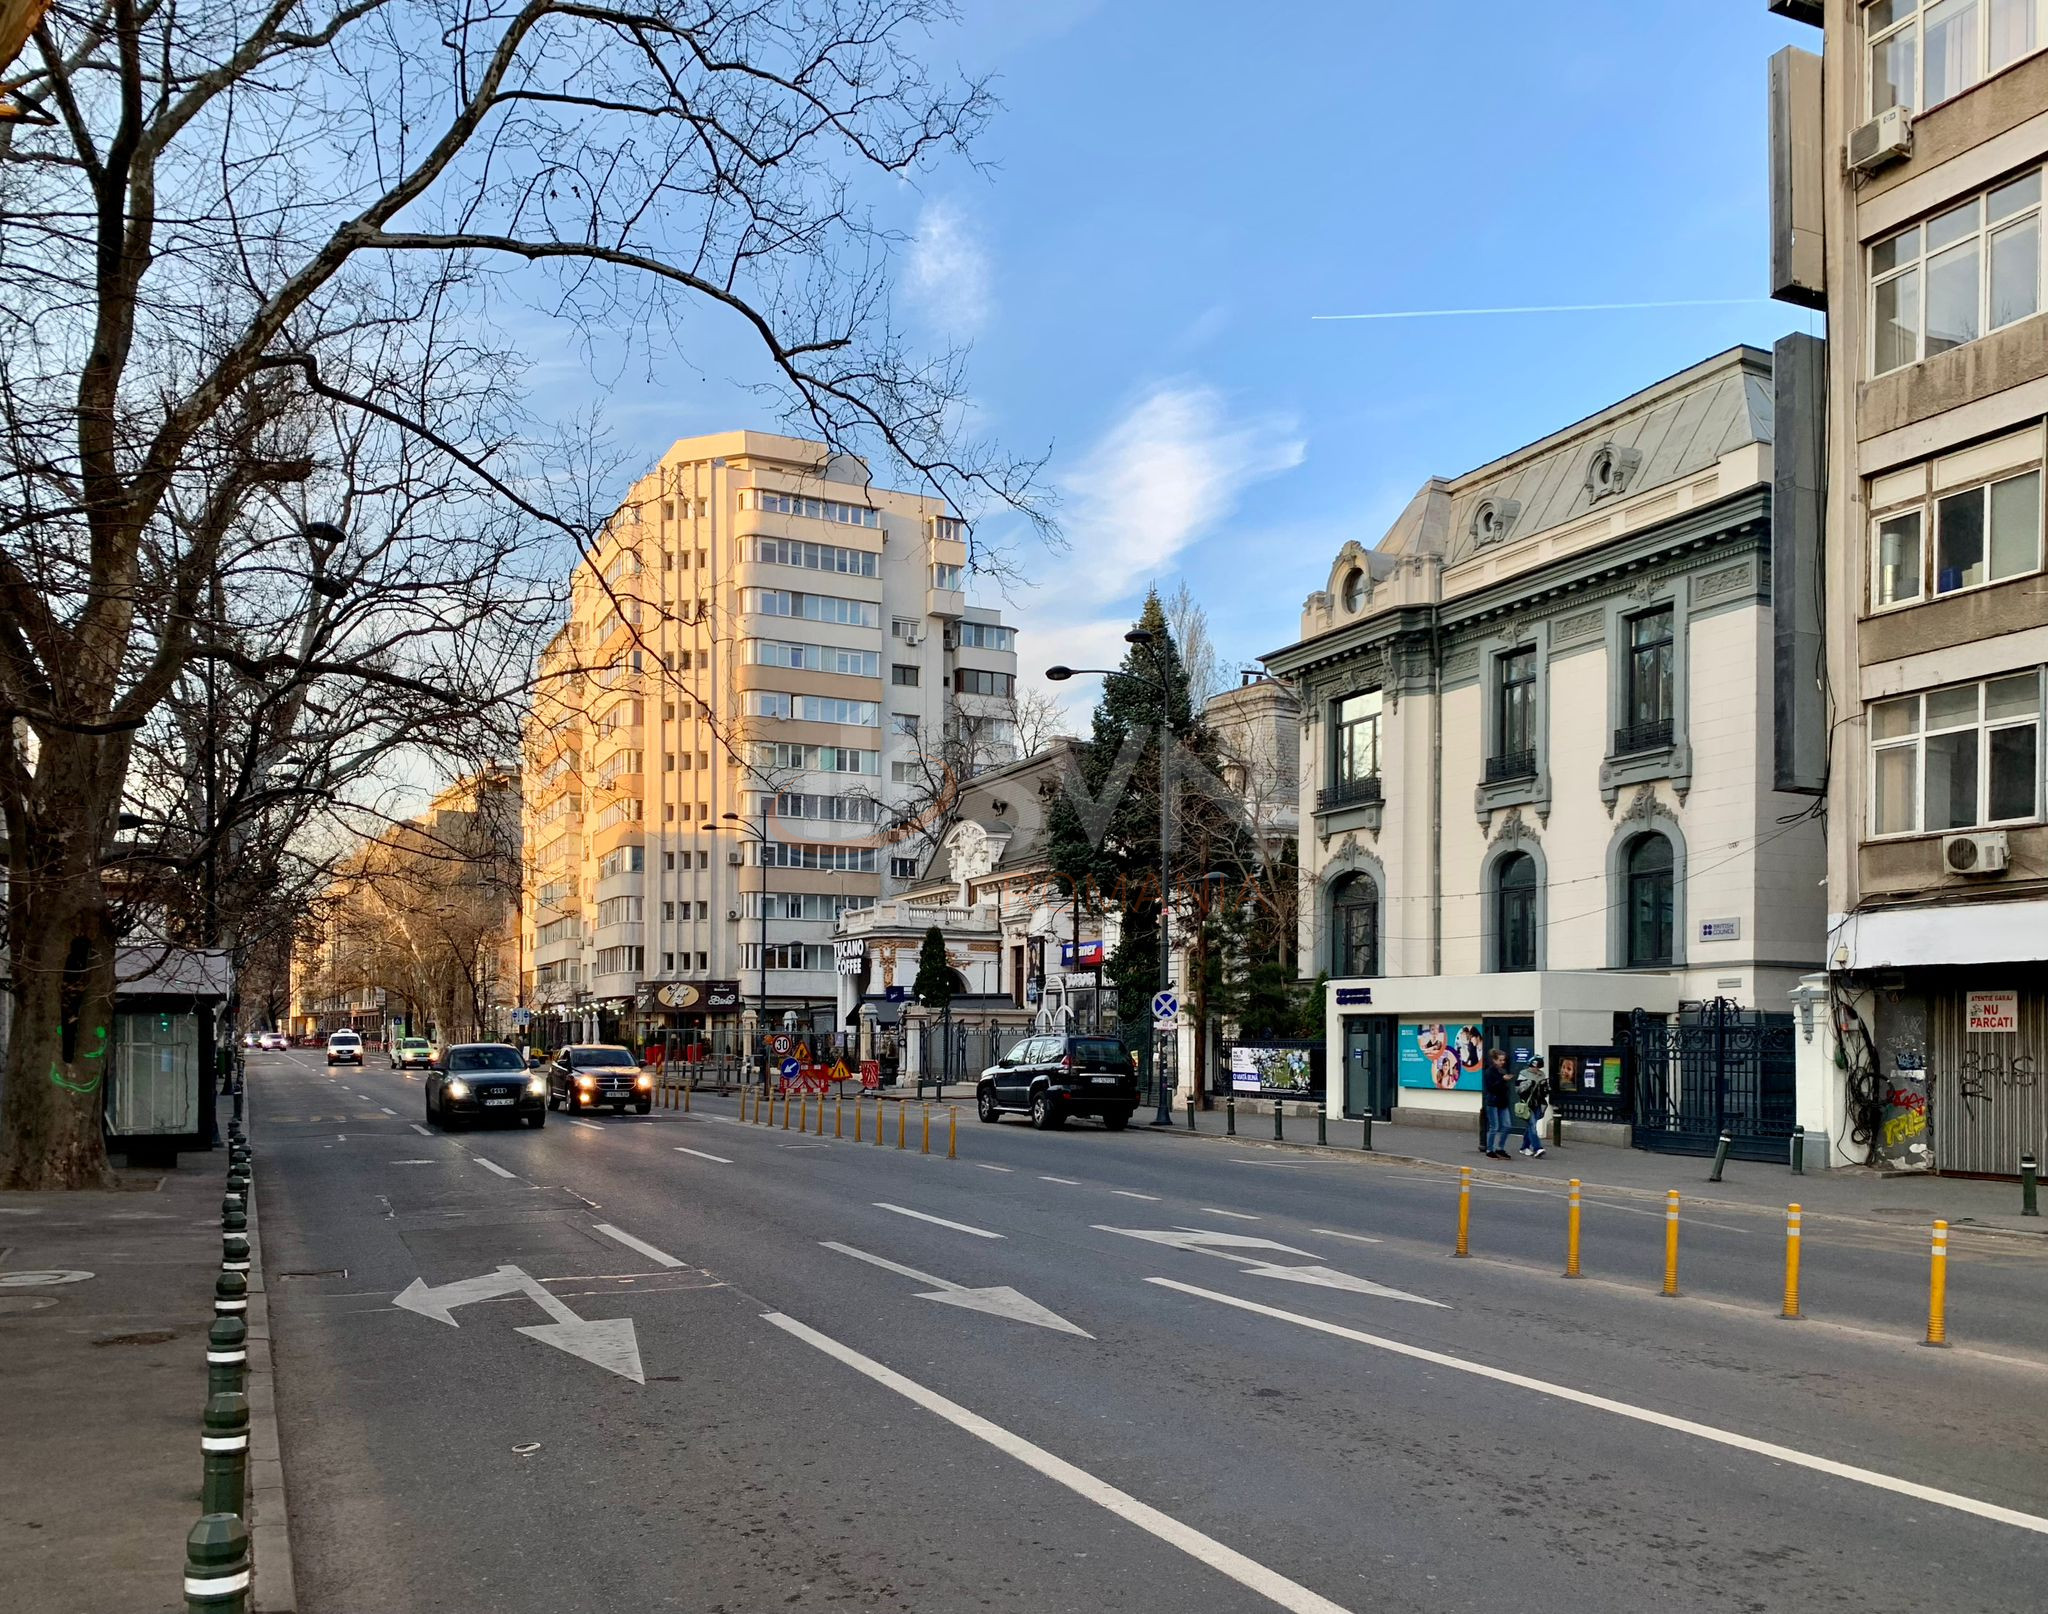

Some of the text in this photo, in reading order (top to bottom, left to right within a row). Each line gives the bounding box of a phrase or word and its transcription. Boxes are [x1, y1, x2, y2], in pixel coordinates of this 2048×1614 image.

[834, 939, 863, 958] TUCANO
[837, 958, 862, 975] COFFEE
[1983, 1004, 1999, 1015] NU
[1970, 1016, 2013, 1028] PARCATI
[776, 1039, 787, 1050] 30
